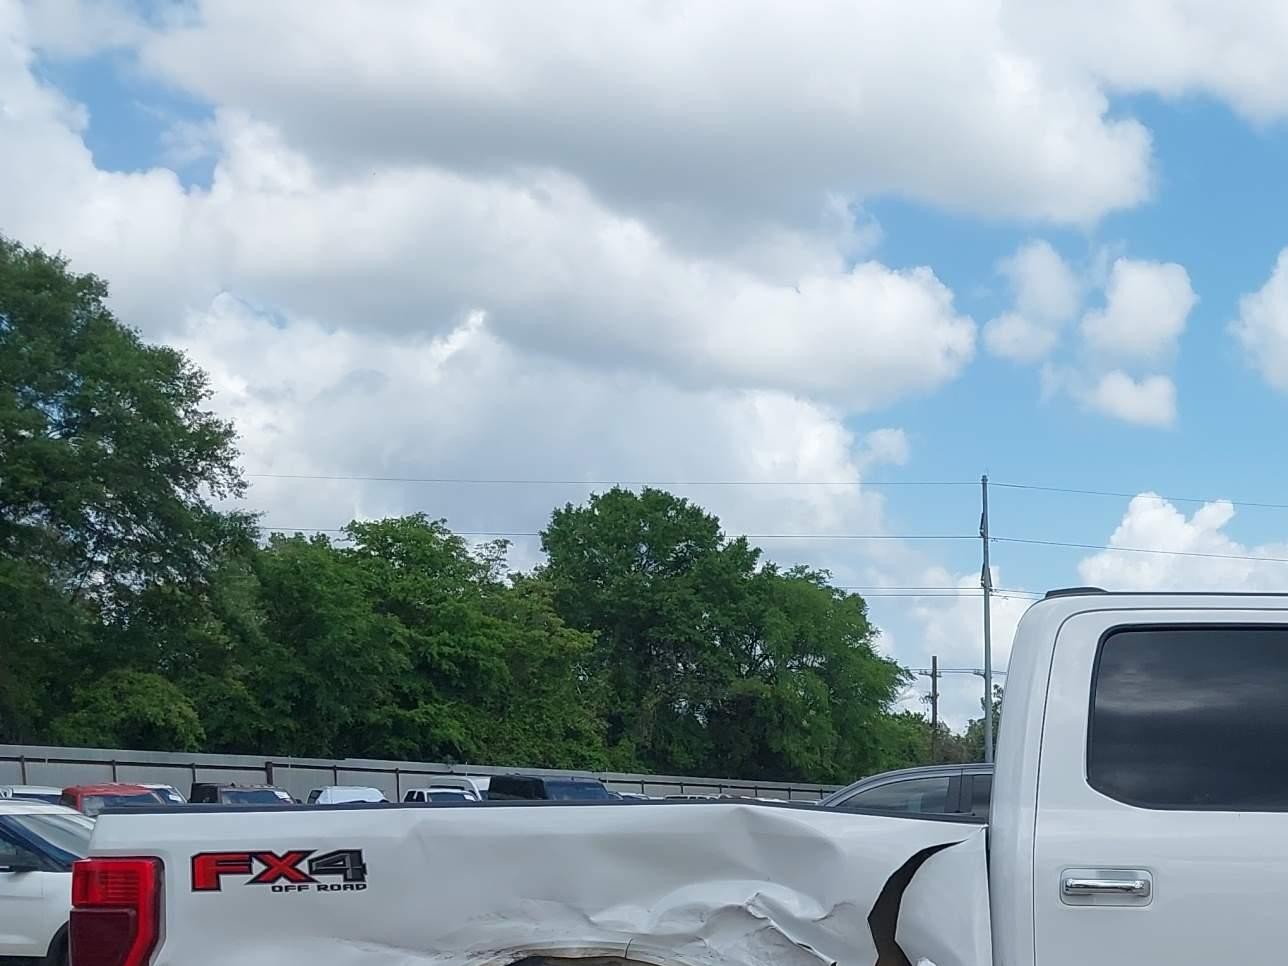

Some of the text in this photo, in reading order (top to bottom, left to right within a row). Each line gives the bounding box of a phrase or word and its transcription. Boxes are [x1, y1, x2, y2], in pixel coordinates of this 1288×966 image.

[191, 849, 367, 892] FX4
[271, 883, 368, 893] OFF ROAD
